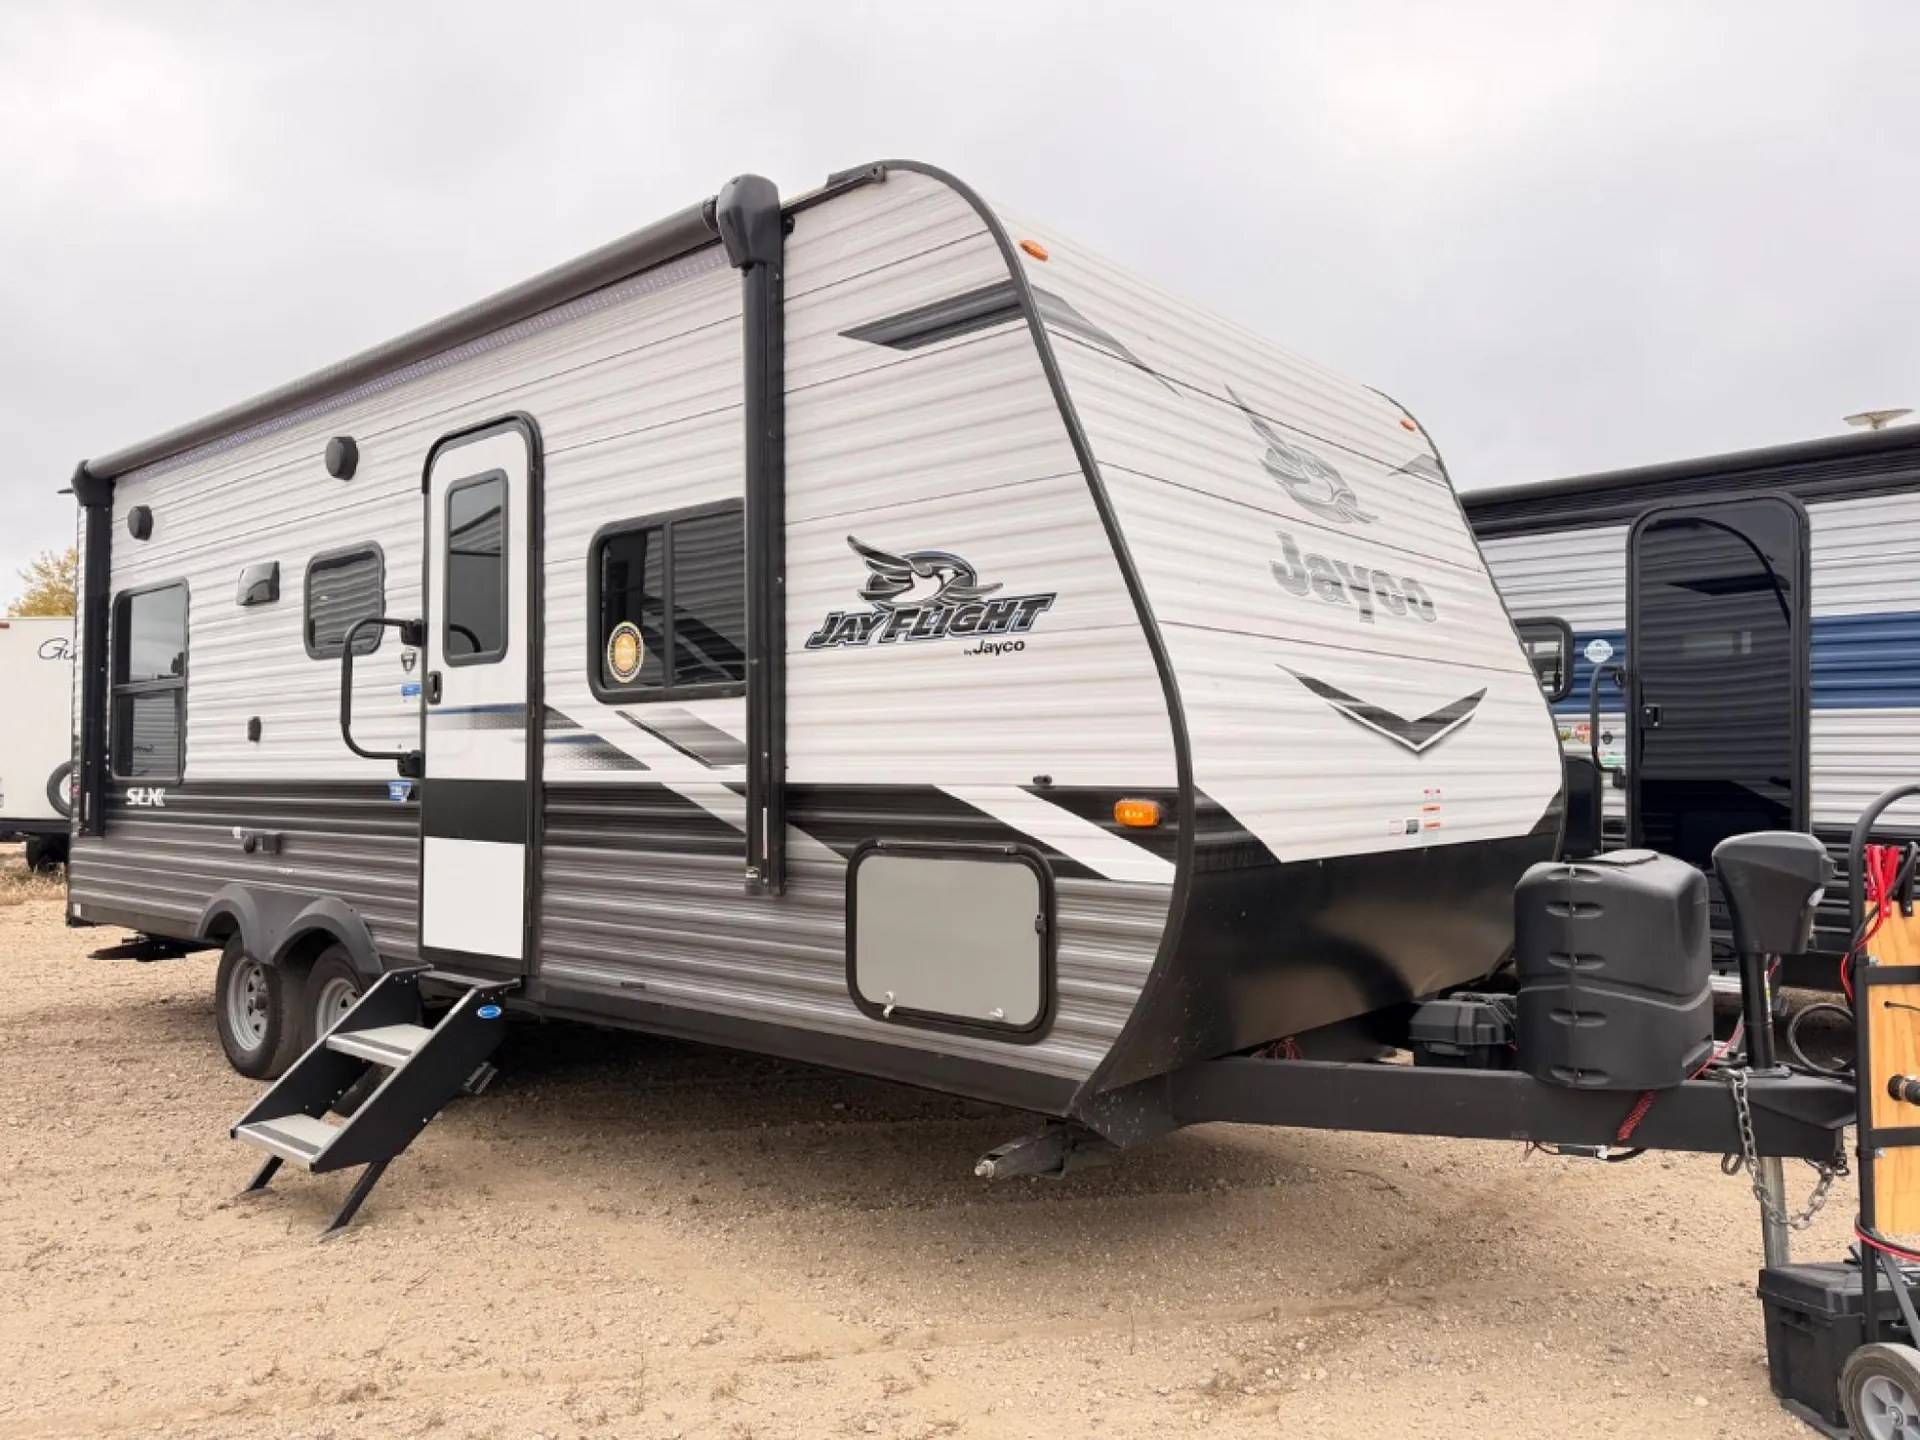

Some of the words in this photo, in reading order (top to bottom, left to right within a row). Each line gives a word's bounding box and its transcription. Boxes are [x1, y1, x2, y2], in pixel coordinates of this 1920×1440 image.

[1270, 531, 1437, 624] Jayco
[805, 610, 889, 649] JAY
[877, 594, 1057, 643] FLIGHT
[972, 639, 1025, 656] Jayco
